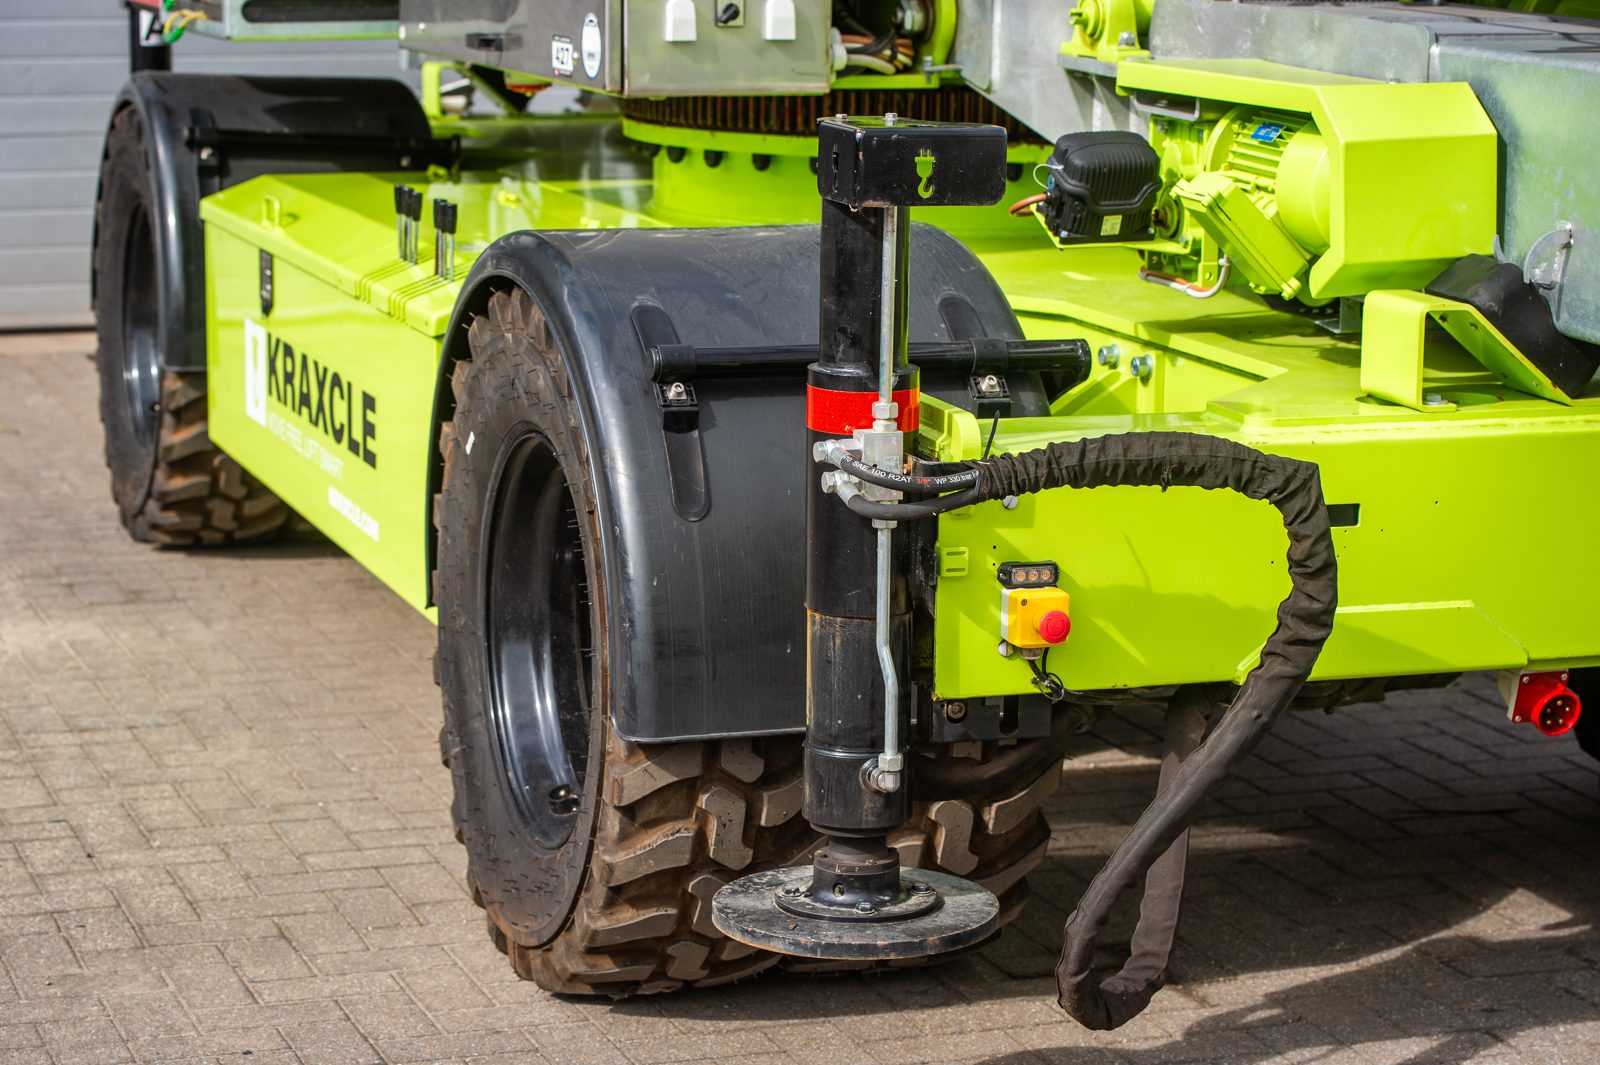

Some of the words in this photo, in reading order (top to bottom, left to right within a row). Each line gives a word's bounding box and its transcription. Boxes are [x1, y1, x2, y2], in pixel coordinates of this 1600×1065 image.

[267, 331, 377, 470] KRAXCLE
[852, 460, 869, 472] SAE
[871, 468, 887, 478] 100
[888, 473, 912, 483] R2AT
[934, 477, 948, 485] WP
